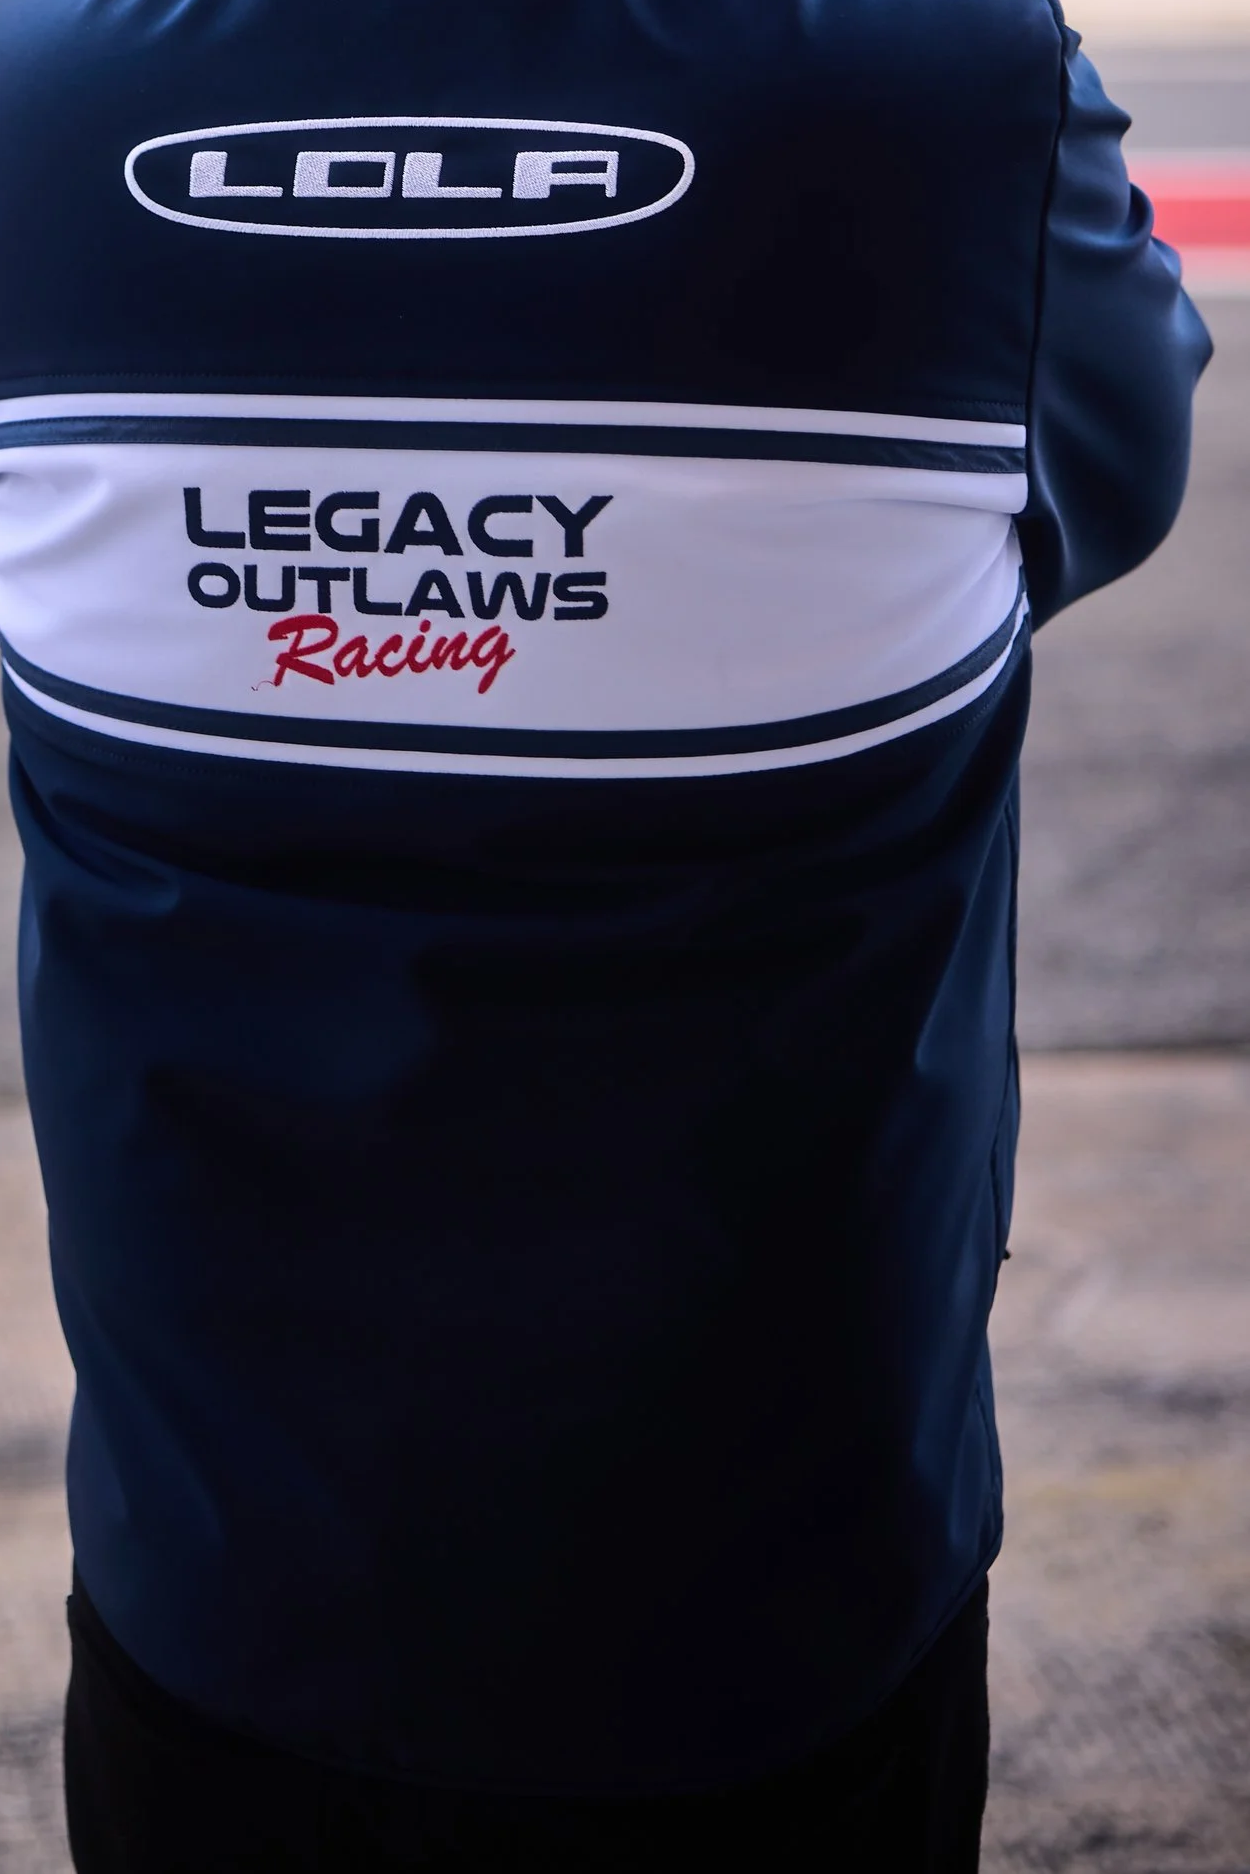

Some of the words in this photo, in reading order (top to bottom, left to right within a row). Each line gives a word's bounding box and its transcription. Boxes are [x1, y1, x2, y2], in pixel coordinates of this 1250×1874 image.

[188, 150, 620, 200] LOLA
[183, 486, 614, 559] LEGACY
[187, 561, 609, 622] OUTLAWS
[267, 613, 516, 694] Racing
